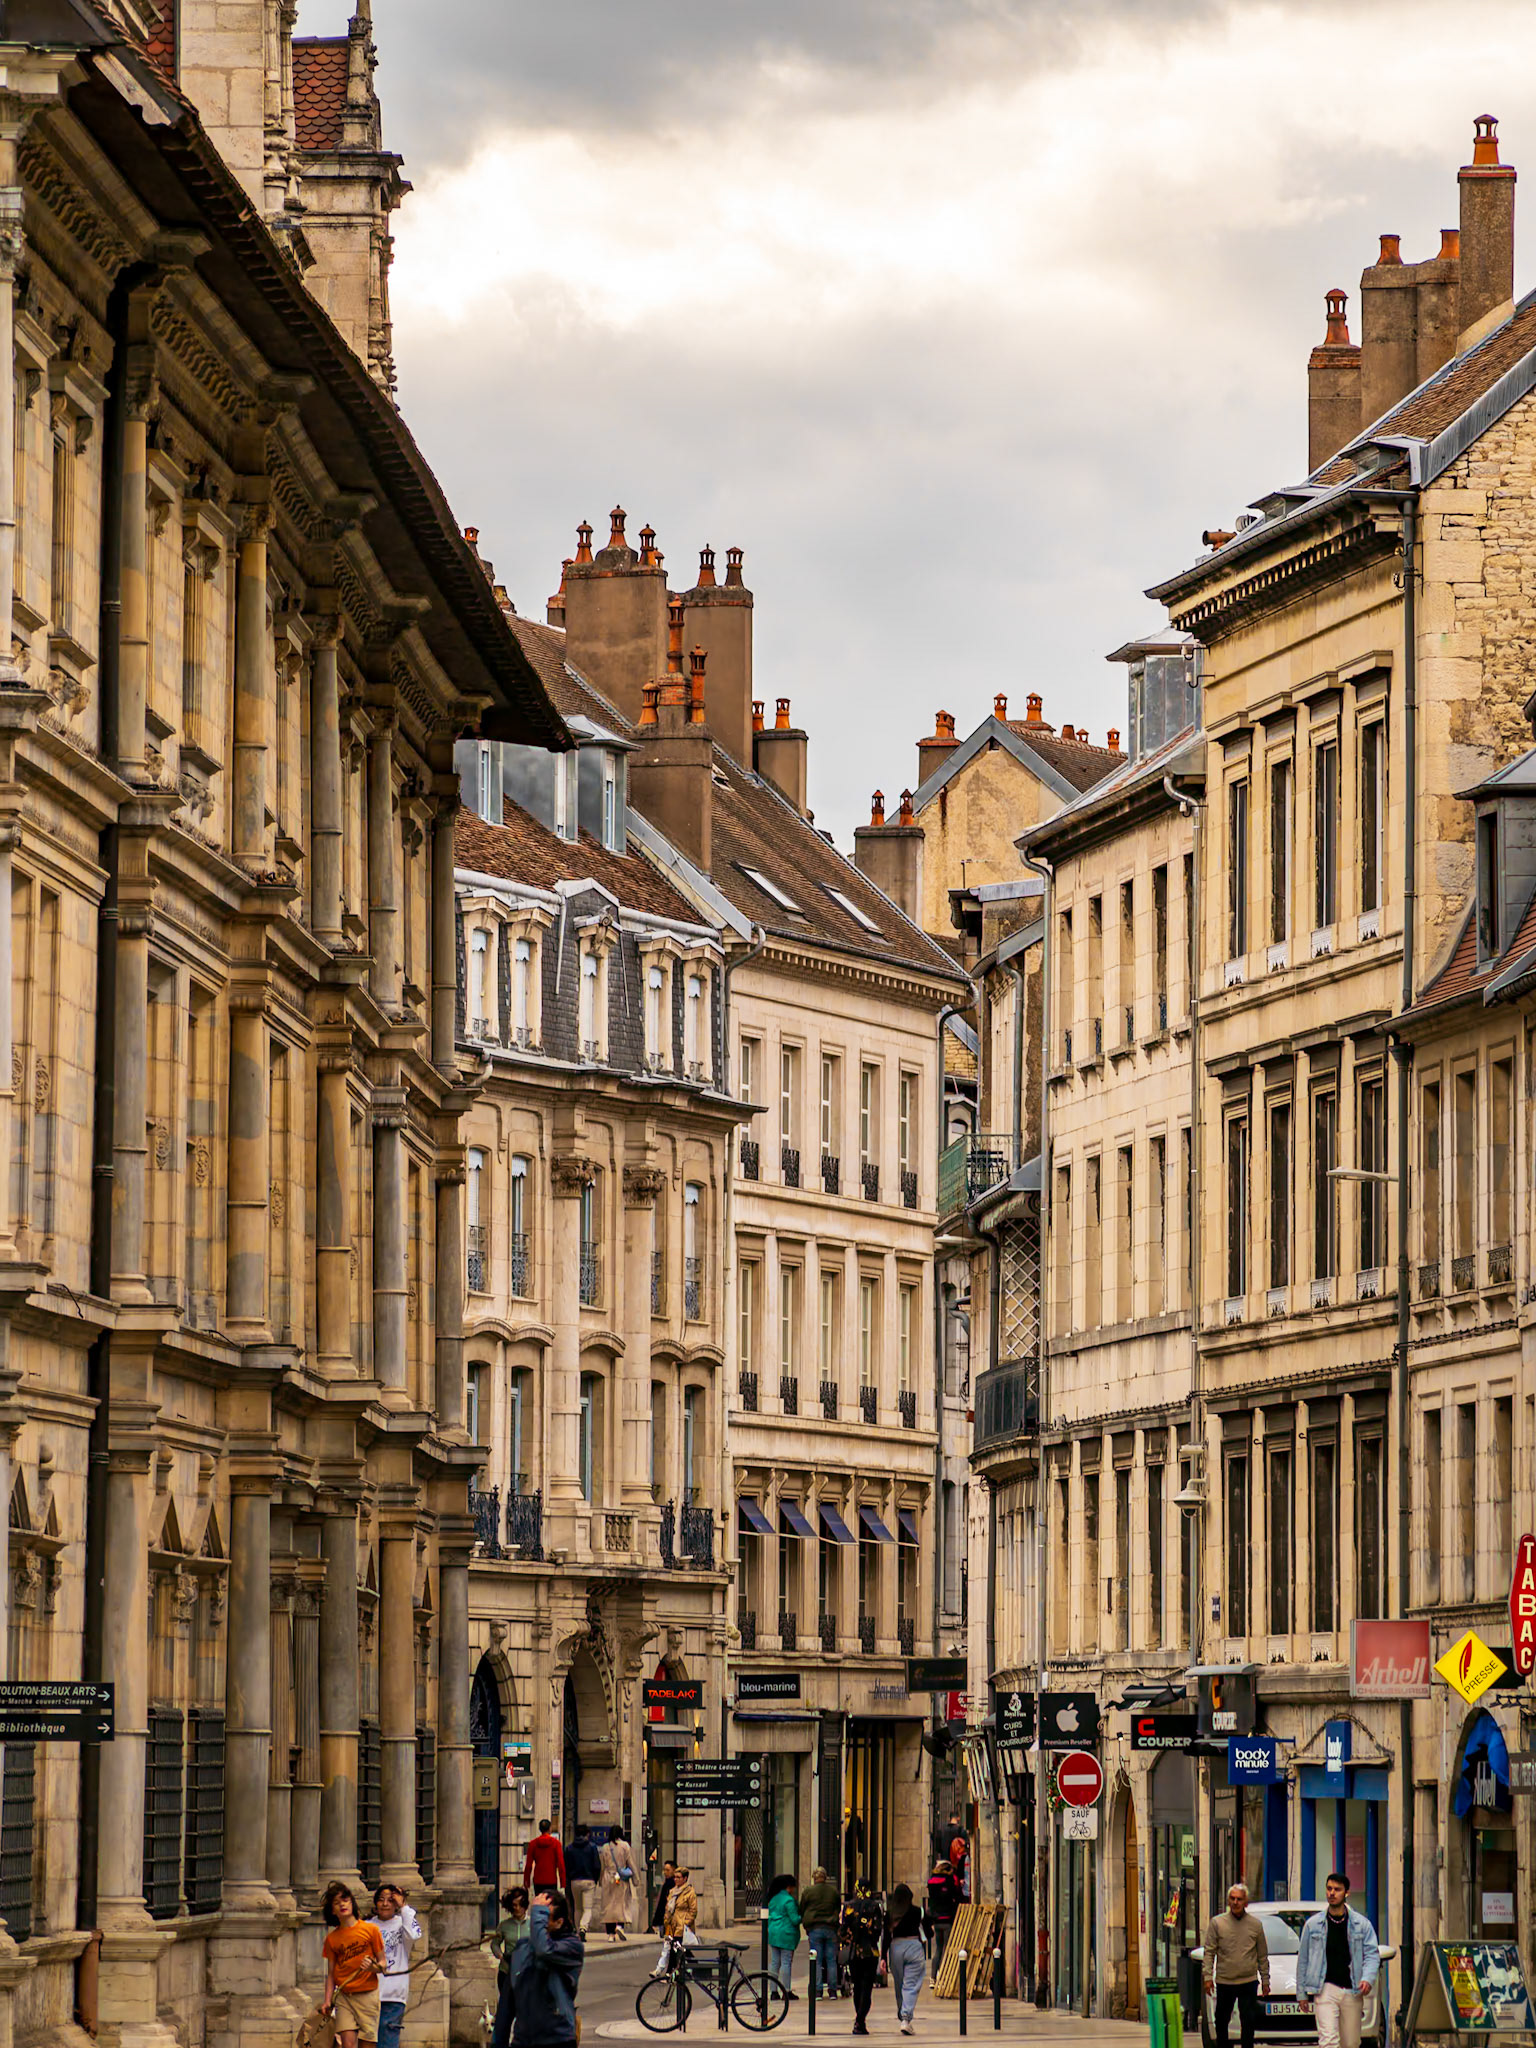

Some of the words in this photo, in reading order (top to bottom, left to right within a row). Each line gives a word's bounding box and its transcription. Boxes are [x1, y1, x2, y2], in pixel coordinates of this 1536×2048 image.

[1518, 1541, 1536, 1669] TABAC
[1359, 1656, 1427, 1685] Arbell
[1463, 1659, 1499, 1695] PRESSE
[72, 1686, 97, 1696] ARTS
[647, 1689, 697, 1700] TADELAKT
[1357, 1687, 1429, 1695] CHAUSSURES
[1003, 1721, 1023, 1731] CUIRS
[1212, 1712, 1238, 1730] COURIR
[0, 1723, 66, 1735] Bibliothèque
[1010, 1730, 1017, 1738] ET
[996, 1735, 1033, 1748] FOURRURES
[1137, 1737, 1193, 1747] COURIR
[1235, 1748, 1270, 1760] body
[1234, 1758, 1269, 1768] minute
[1071, 1809, 1090, 1818] SAUF
